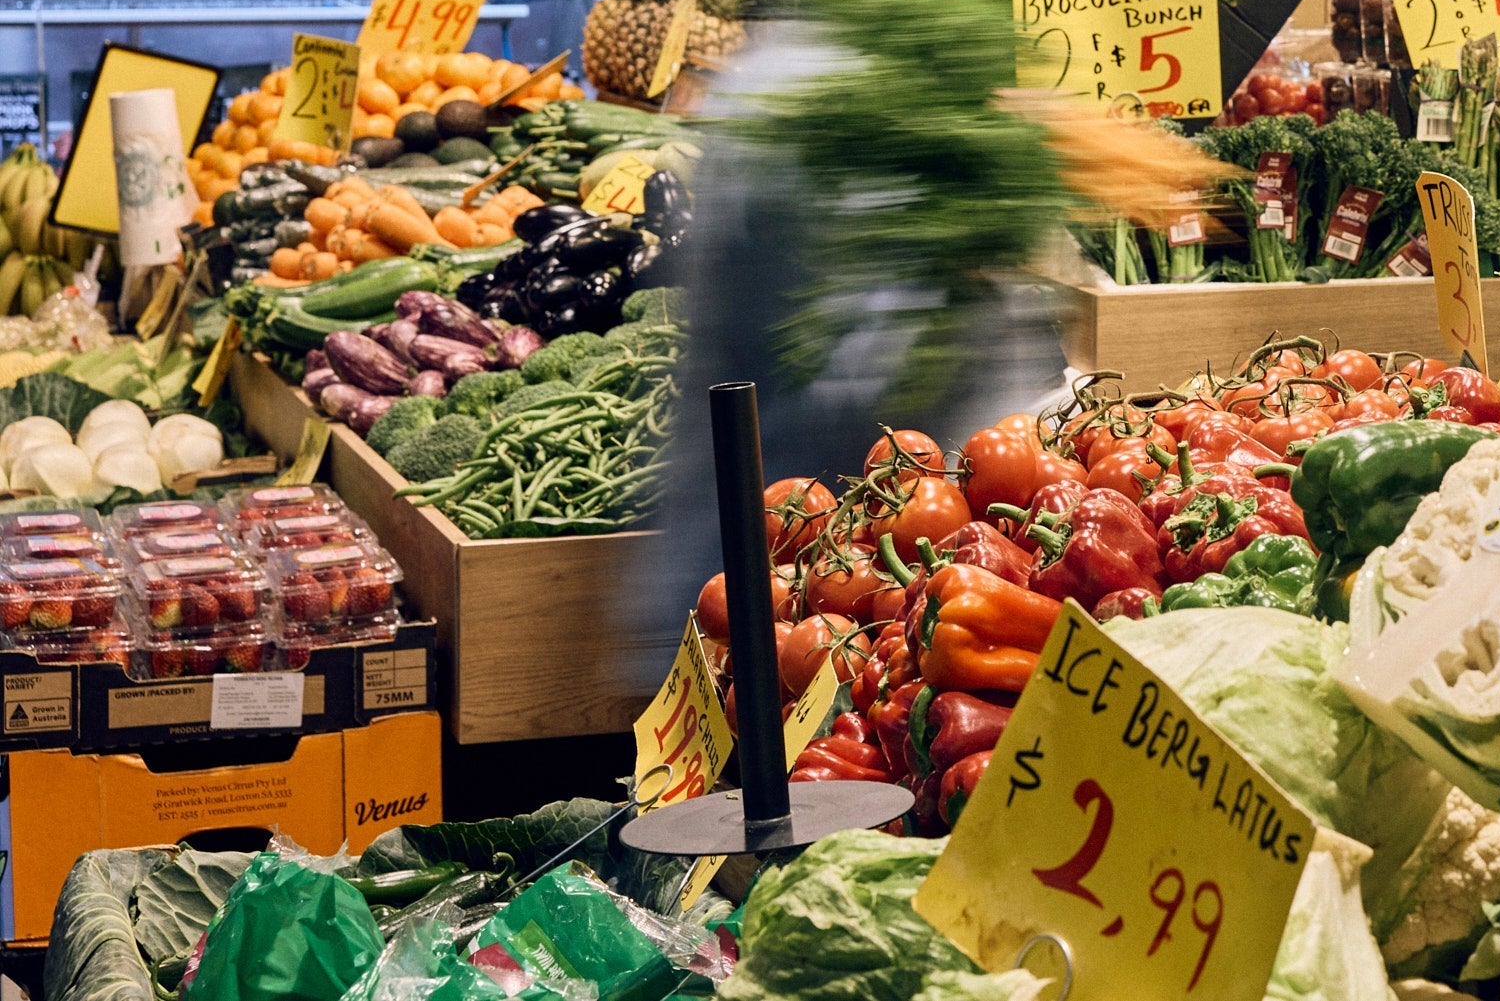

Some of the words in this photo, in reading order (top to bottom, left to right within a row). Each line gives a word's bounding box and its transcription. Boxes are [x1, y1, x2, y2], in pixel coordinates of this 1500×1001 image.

[1123, 5, 1203, 29] BUNCH
[366, 657, 388, 667] COUNT
[366, 679, 392, 688] WEIGHT
[114, 690, 146, 699] GROWN
[375, 691, 414, 704] 75MM
[32, 705, 50, 714] Grown
[32, 713, 67, 722] Australia
[169, 726, 208, 735] PRODUCE
[1044, 617, 1124, 714] ICE
[1212, 763, 1301, 865] LATUS
[156, 787, 187, 798] Packed
[201, 782, 227, 793] Venus
[227, 779, 255, 791] Citrus
[255, 778, 270, 789] Pty
[271, 777, 287, 787] Ltd
[355, 792, 429, 826] Venus
